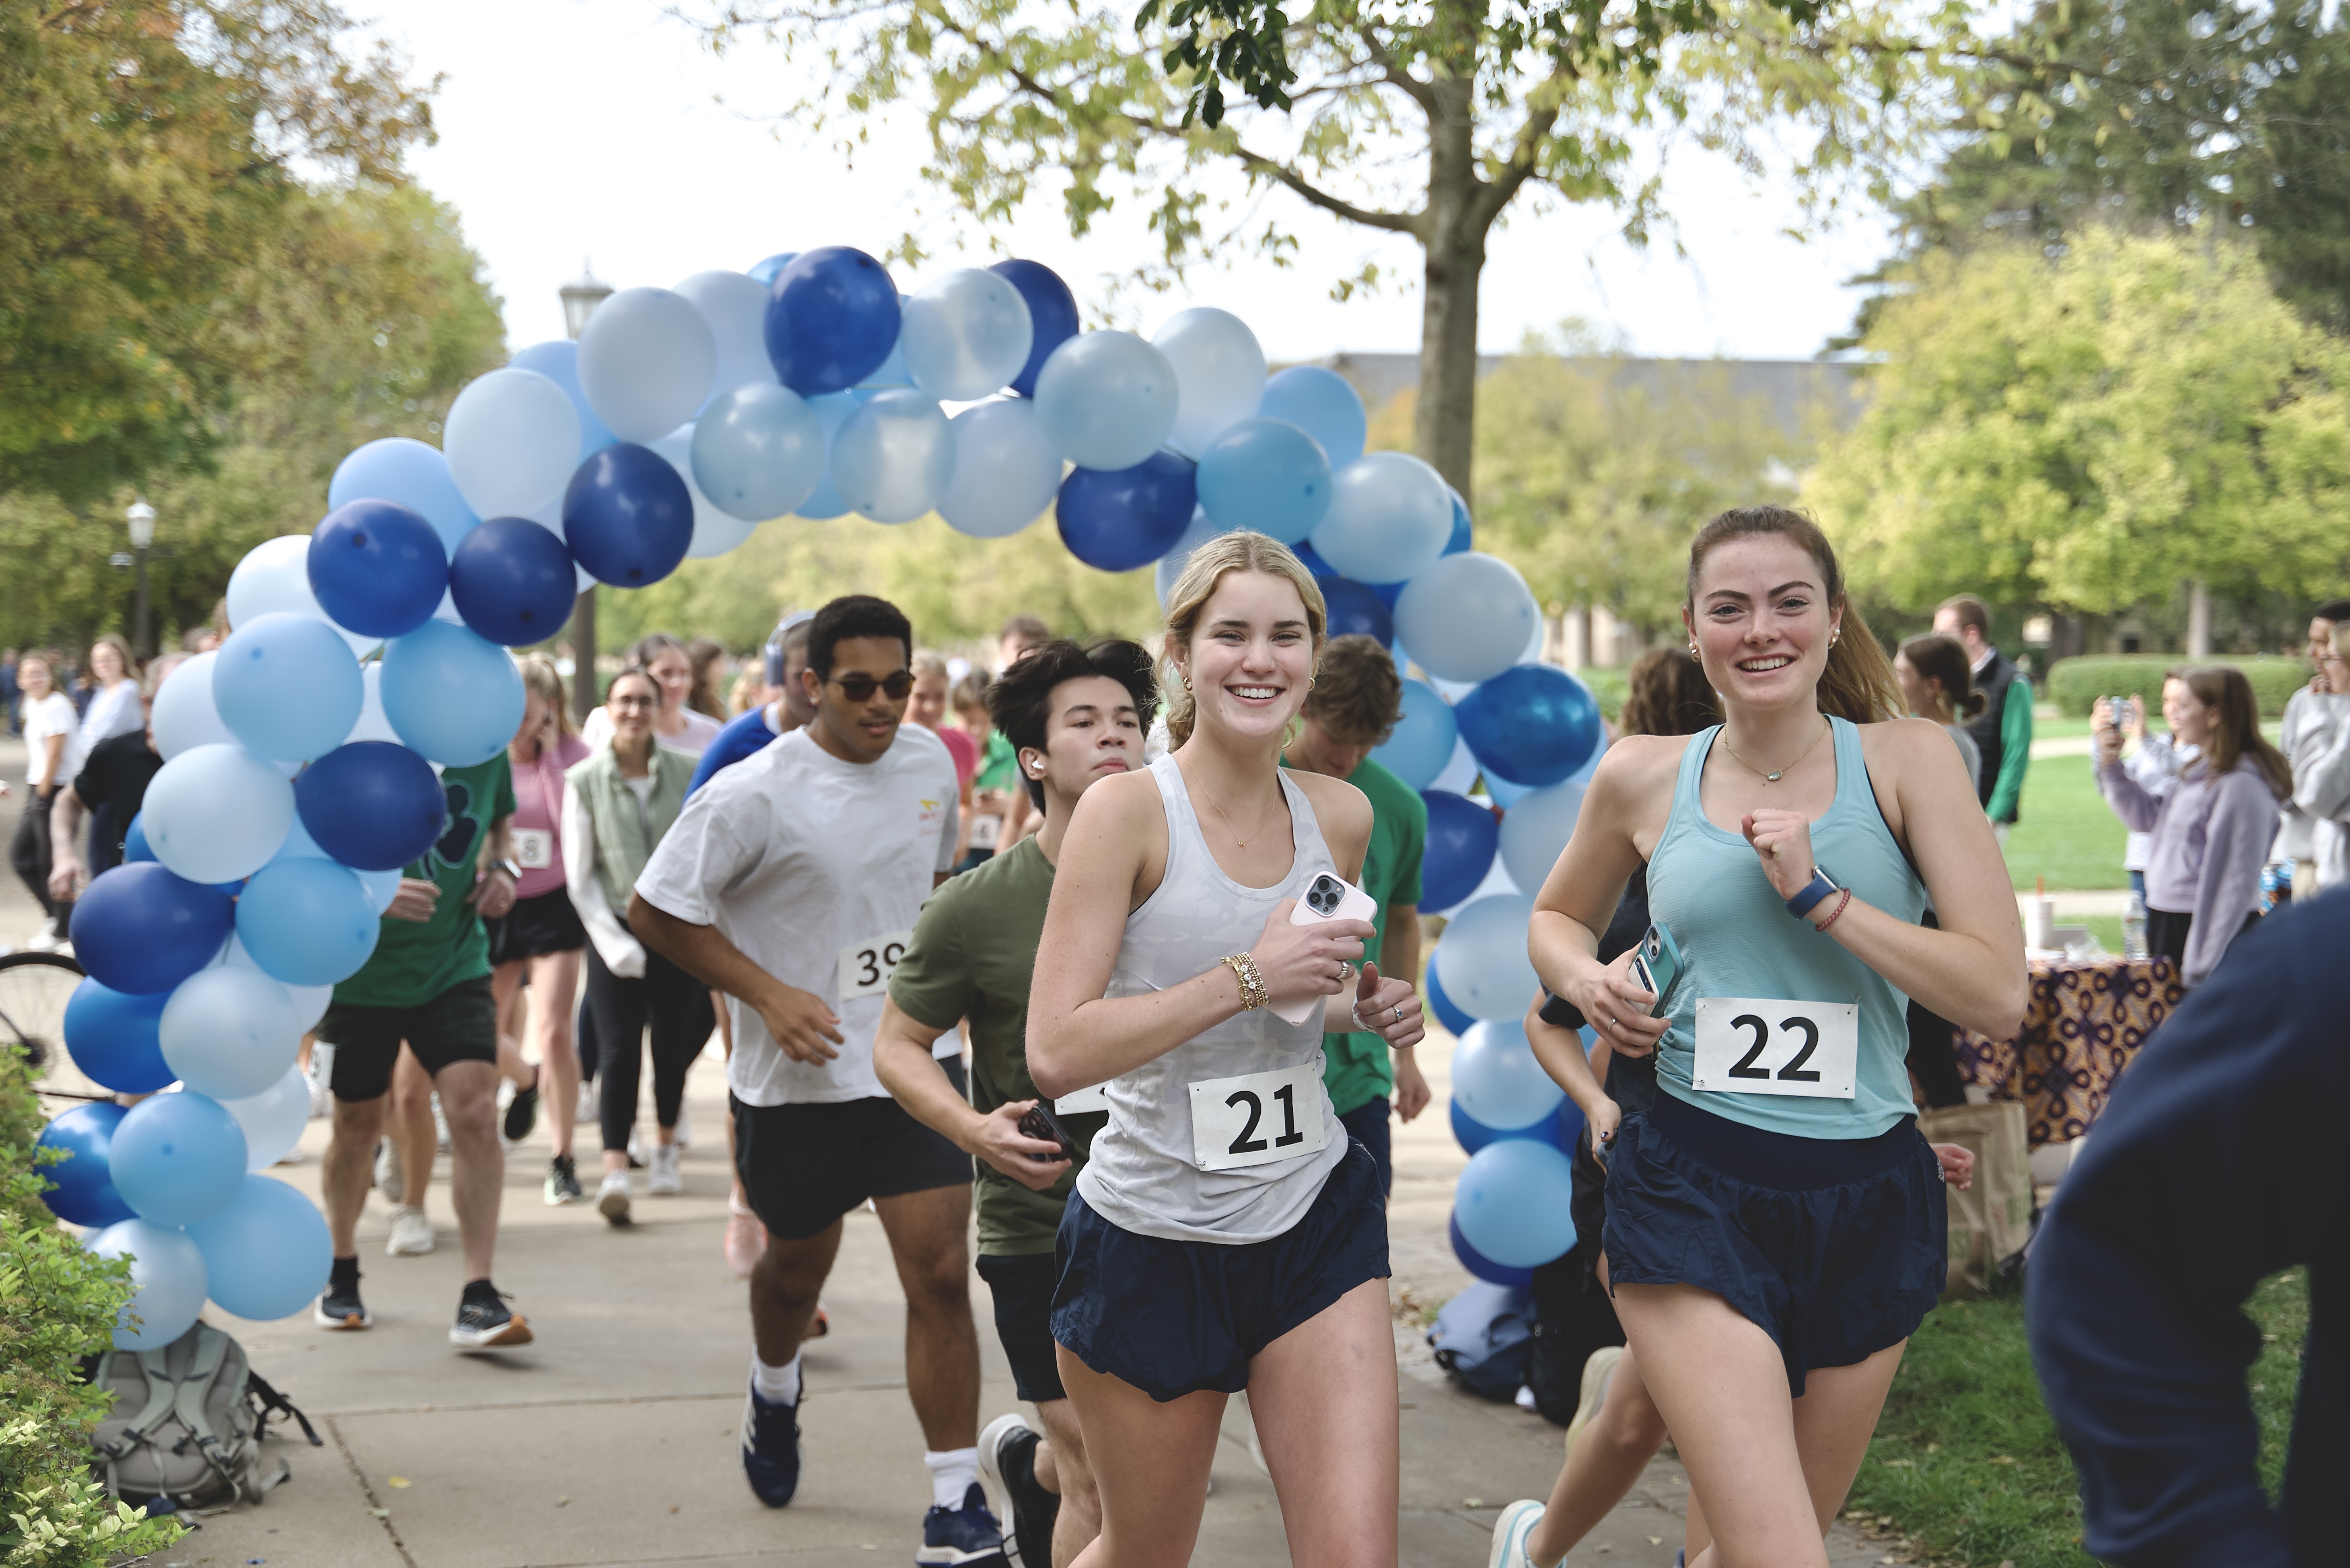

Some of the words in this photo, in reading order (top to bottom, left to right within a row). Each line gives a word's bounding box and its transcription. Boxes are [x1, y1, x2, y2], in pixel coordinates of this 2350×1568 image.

[857, 943, 905, 986] 39
[1729, 1014, 1820, 1082] 22
[1225, 1084, 1303, 1155] 21
